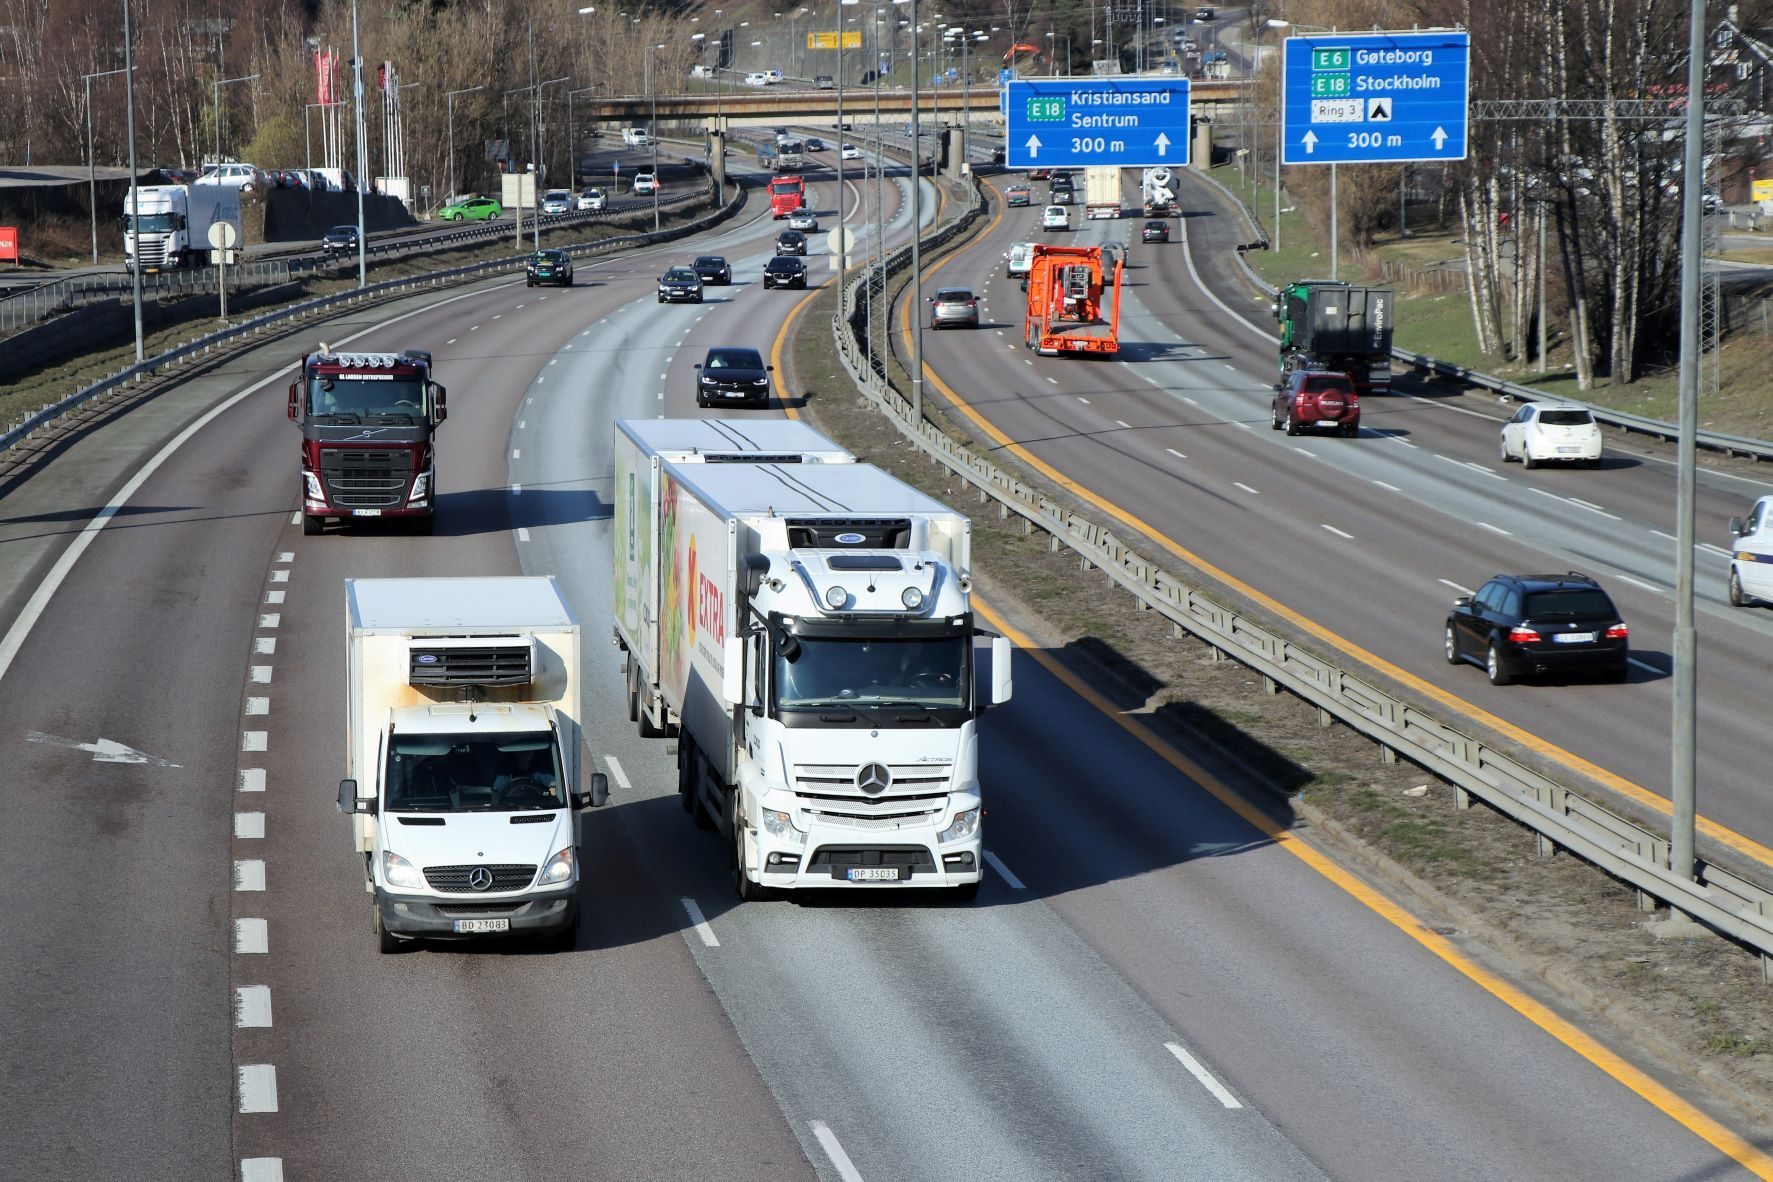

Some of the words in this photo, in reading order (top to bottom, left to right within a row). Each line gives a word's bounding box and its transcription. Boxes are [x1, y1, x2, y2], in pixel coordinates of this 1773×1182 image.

[1320, 52, 1329, 65] E
[1333, 51, 1343, 65] 6
[1356, 49, 1433, 67] Gøteborg
[1317, 78, 1326, 91] E
[1330, 78, 1345, 91] 18
[1356, 74, 1441, 91] Stockholm
[1071, 89, 1170, 106] Kristiansand
[1032, 103, 1041, 116] E
[1045, 103, 1060, 116] 18
[1319, 105, 1344, 118] Ring
[1349, 104, 1356, 115] 3
[1071, 113, 1138, 128] Sentrum
[1071, 137, 1105, 153] 300
[1110, 140, 1125, 152] m
[1348, 132, 1382, 148] 300
[1387, 134, 1402, 147] m
[1374, 298, 1384, 340] EnviroPac
[700, 572, 725, 649] EXTRA
[854, 870, 866, 878] DP
[462, 921, 474, 930] BD
